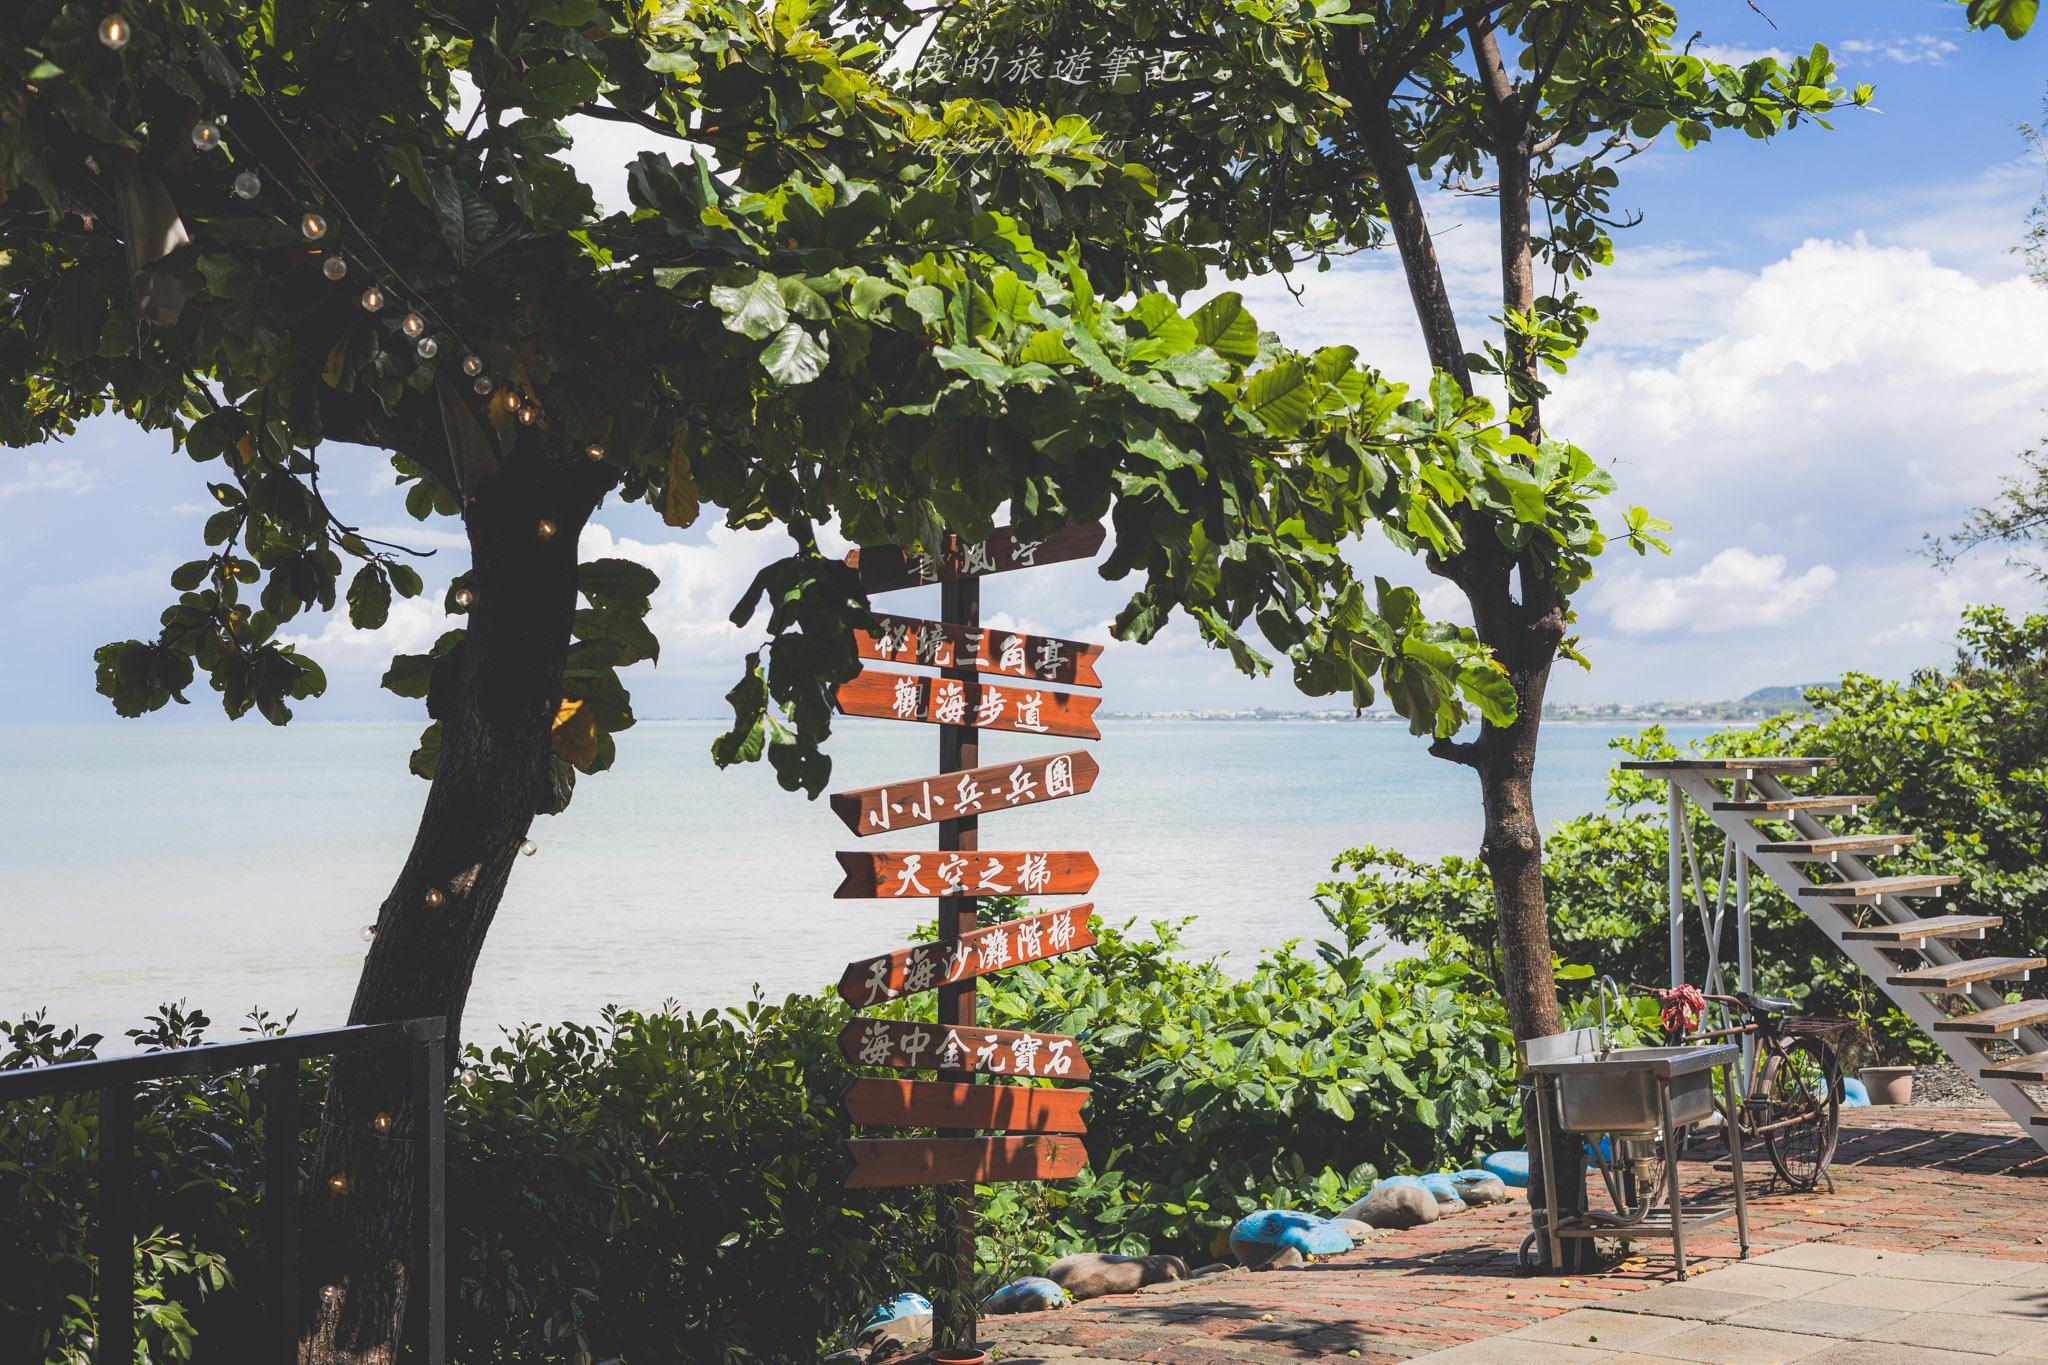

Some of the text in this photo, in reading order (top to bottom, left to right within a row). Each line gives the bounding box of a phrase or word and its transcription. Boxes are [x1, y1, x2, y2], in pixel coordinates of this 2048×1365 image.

[892, 676, 1050, 732] 觀海步道
[895, 853, 1052, 895] 天空之梯
[864, 910, 1076, 1006] 天海沙灘階梯
[859, 1021, 1073, 1076] 海中金元寶石
